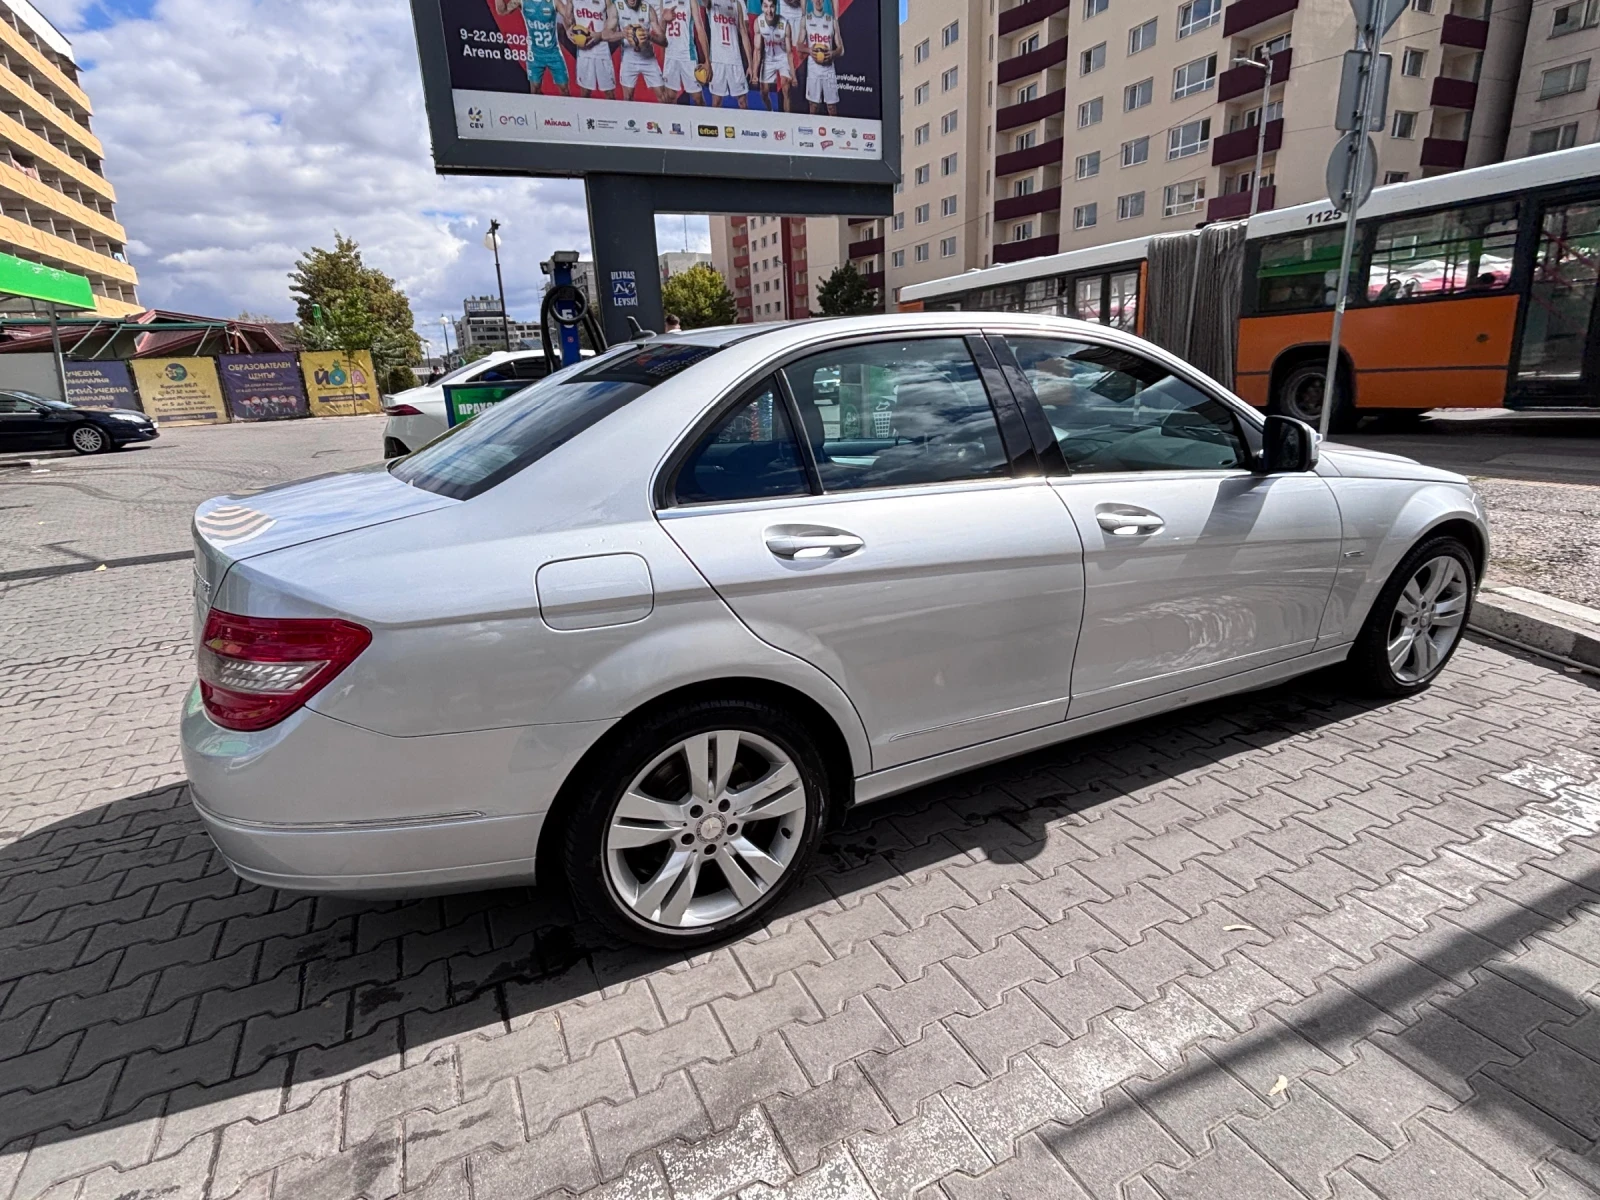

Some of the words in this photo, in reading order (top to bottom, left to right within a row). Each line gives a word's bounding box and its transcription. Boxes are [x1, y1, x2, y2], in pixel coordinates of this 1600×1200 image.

[576, 8, 603, 21] efbet
[713, 13, 737, 26] efbet
[668, 22, 681, 37] 23
[534, 31, 552, 47] 22
[809, 33, 832, 44] efbet
[463, 44, 501, 60] Arena
[504, 48, 535, 62] 8888
[499, 114, 529, 127] enel
[700, 127, 718, 135] efbet
[1306, 209, 1342, 226] 1125
[611, 271, 636, 281] ULTRAS
[613, 296, 638, 307] LEVSKI
[228, 361, 291, 371] ОБРАЗОВАТЕЛЕН
[248, 372, 276, 380] ЦЕНТЪР
